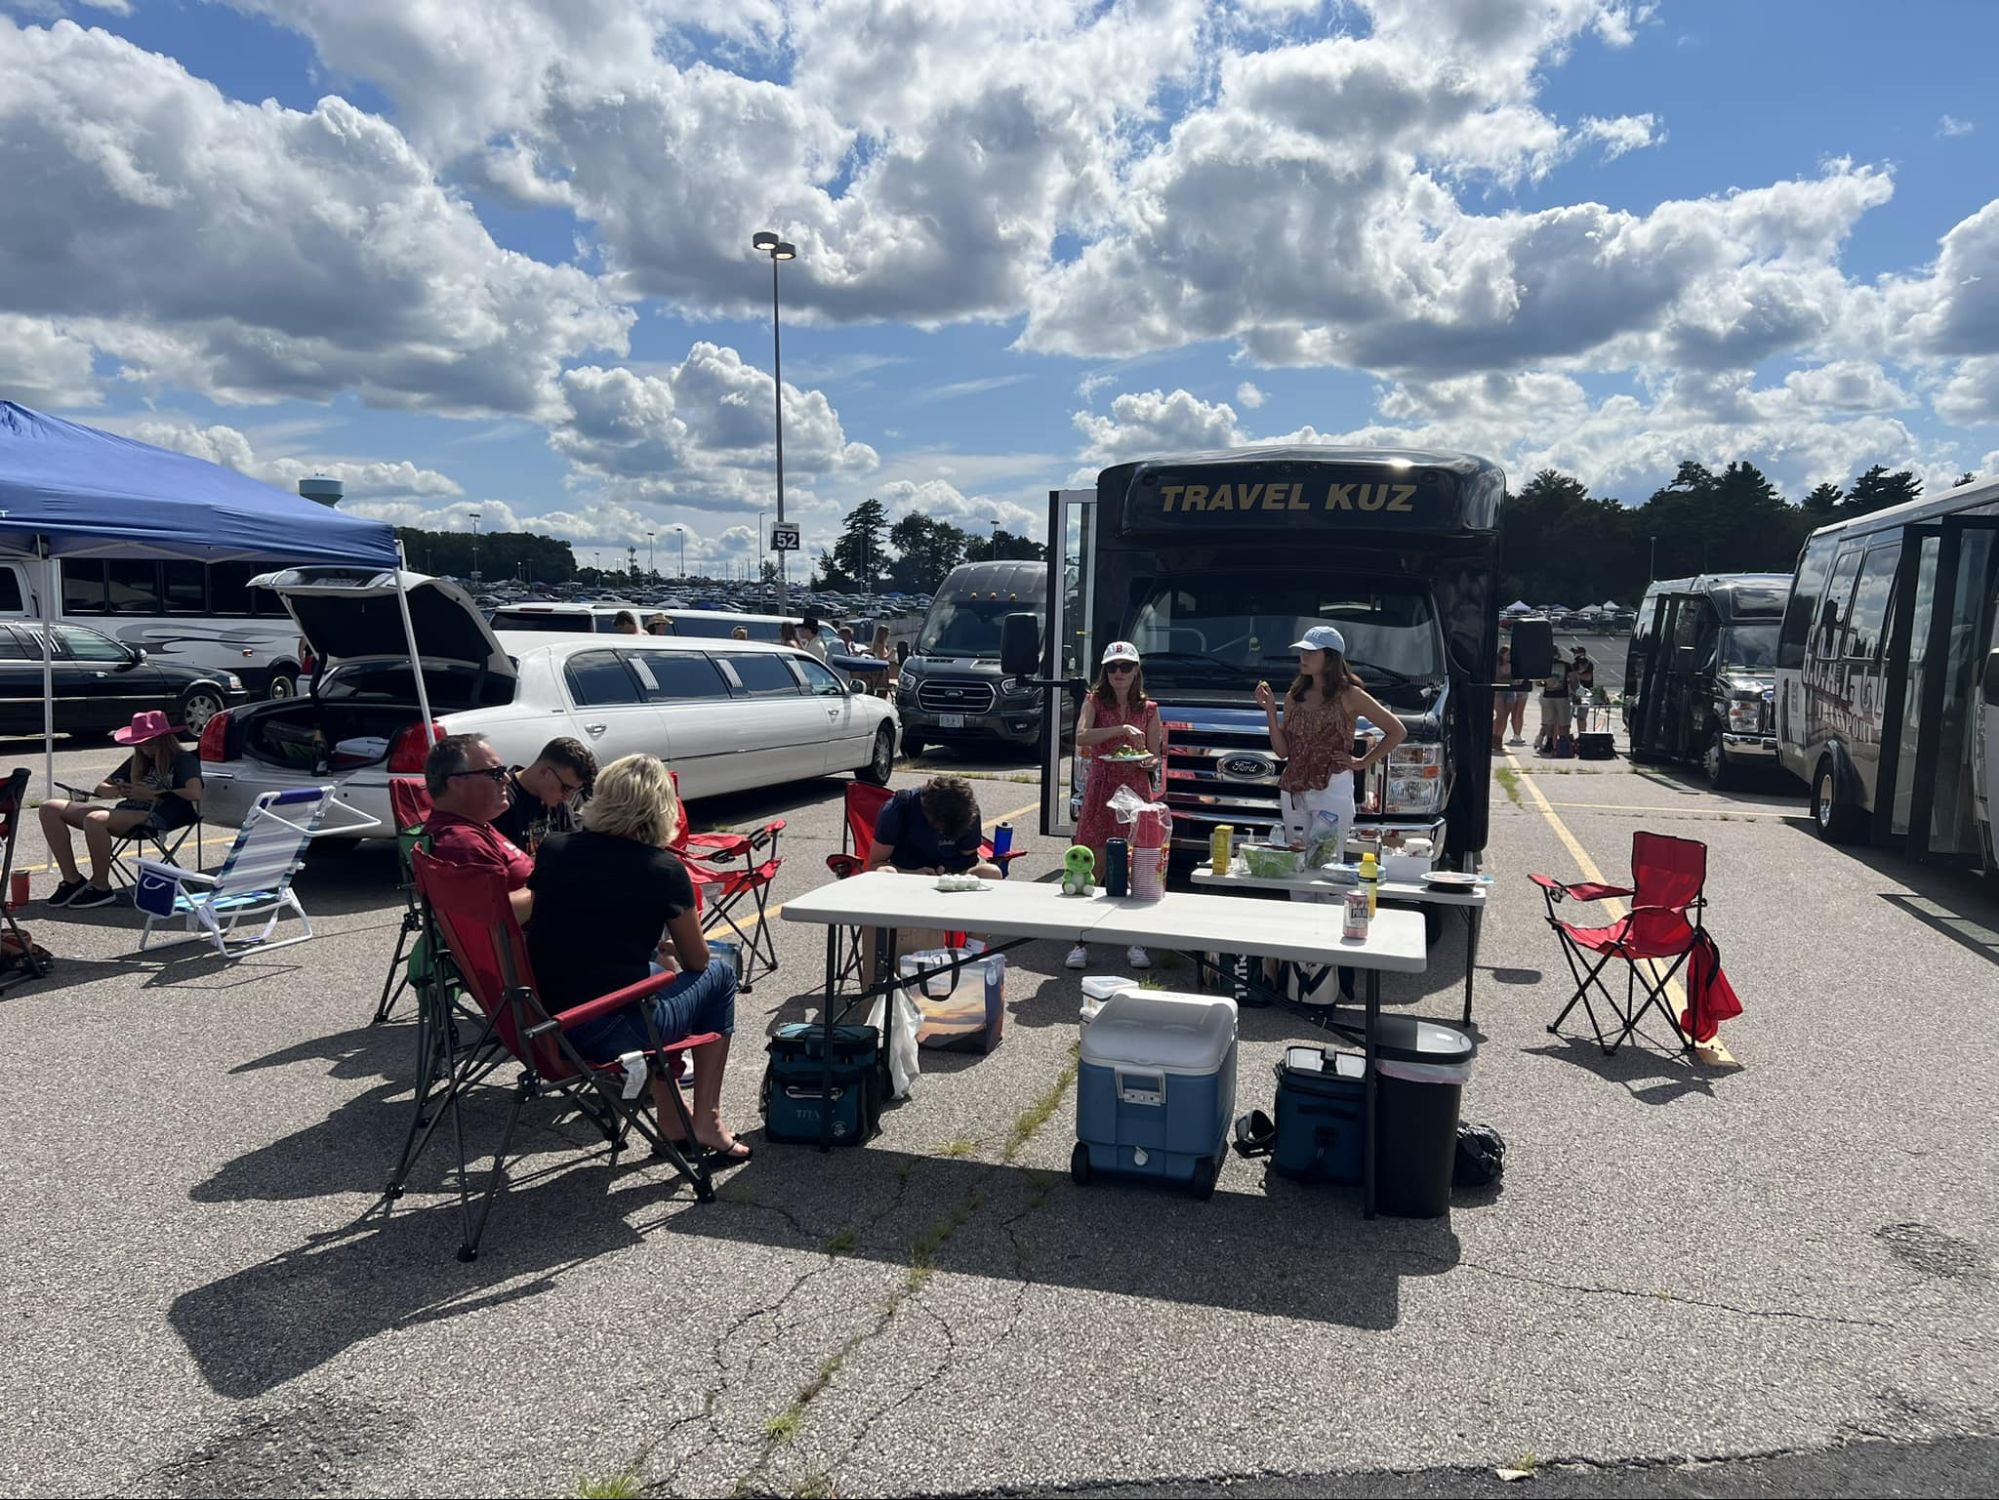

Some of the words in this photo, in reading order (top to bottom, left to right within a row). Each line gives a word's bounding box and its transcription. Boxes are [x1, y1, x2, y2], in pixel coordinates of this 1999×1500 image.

[1160, 483, 1310, 512] TRAVEL
[1325, 484, 1417, 511] KUZ
[776, 532, 798, 549] 52
[1115, 644, 1124, 654] B
[1817, 699, 1875, 744] TRANSPORT
[1232, 760, 1258, 773] Ford
